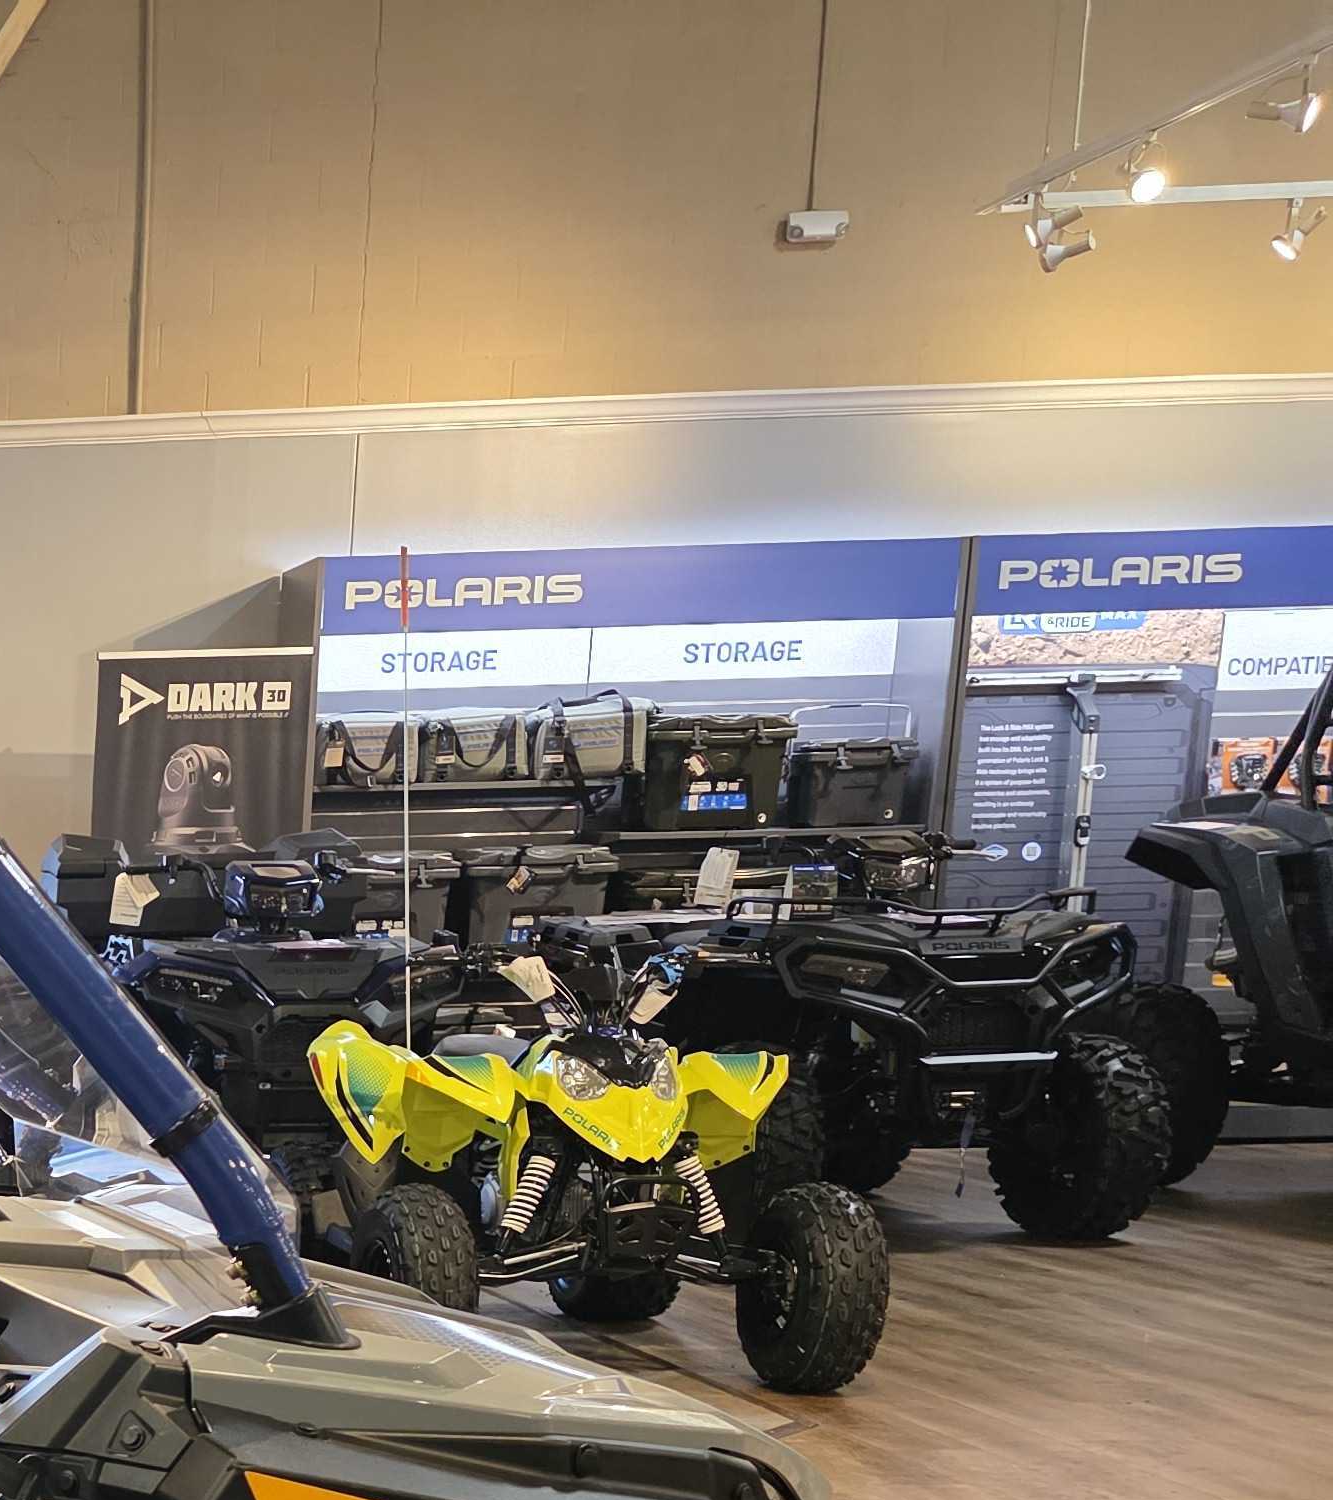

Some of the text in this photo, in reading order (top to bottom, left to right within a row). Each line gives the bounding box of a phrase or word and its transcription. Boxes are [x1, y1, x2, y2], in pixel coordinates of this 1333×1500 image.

[998, 552, 1243, 590] POLARIS
[344, 573, 584, 610] POLARIS
[381, 650, 498, 673] STORAGE
[683, 640, 803, 664] STORAGE
[167, 681, 287, 713] DARK 30
[934, 939, 1010, 952] POLARIS
